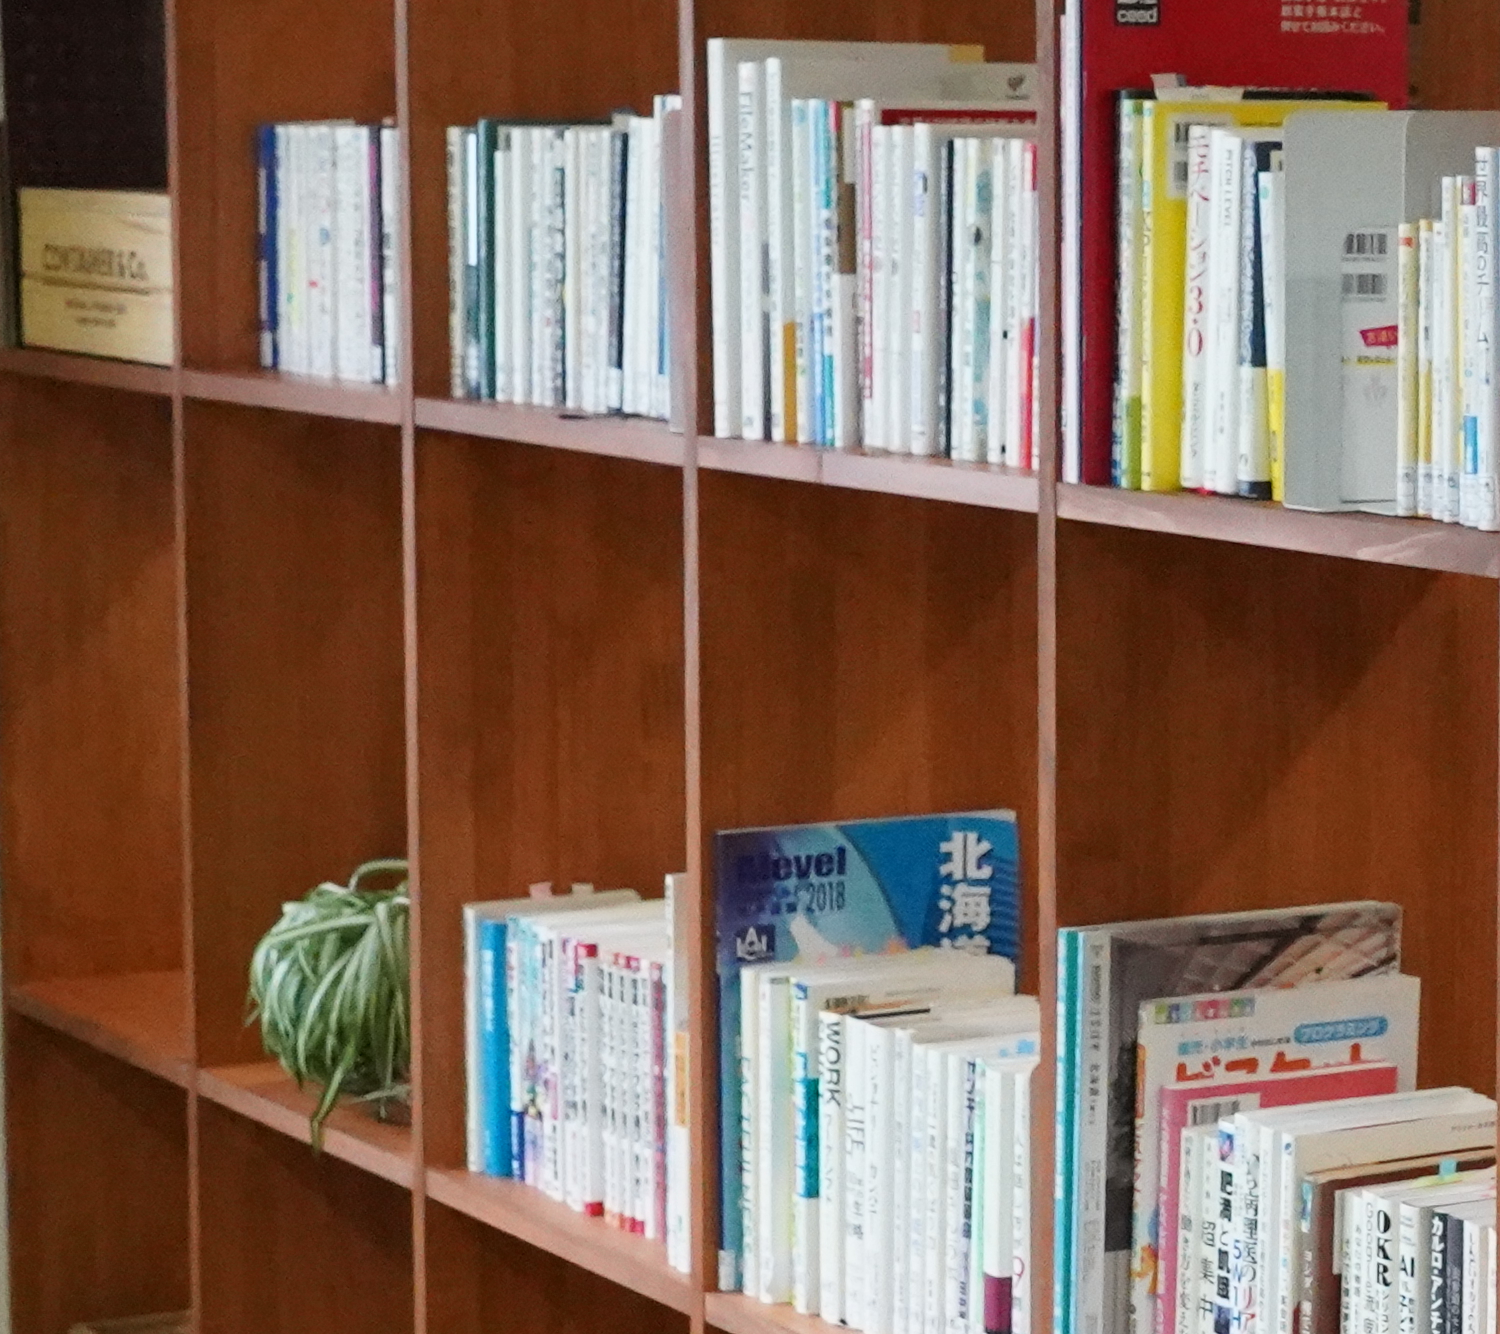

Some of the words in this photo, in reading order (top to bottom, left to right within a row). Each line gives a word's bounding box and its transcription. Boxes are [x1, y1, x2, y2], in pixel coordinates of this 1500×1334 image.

[806, 880, 846, 914] 2018
[824, 1020, 841, 1108] WORK
[1375, 1209, 1392, 1287] OKR
